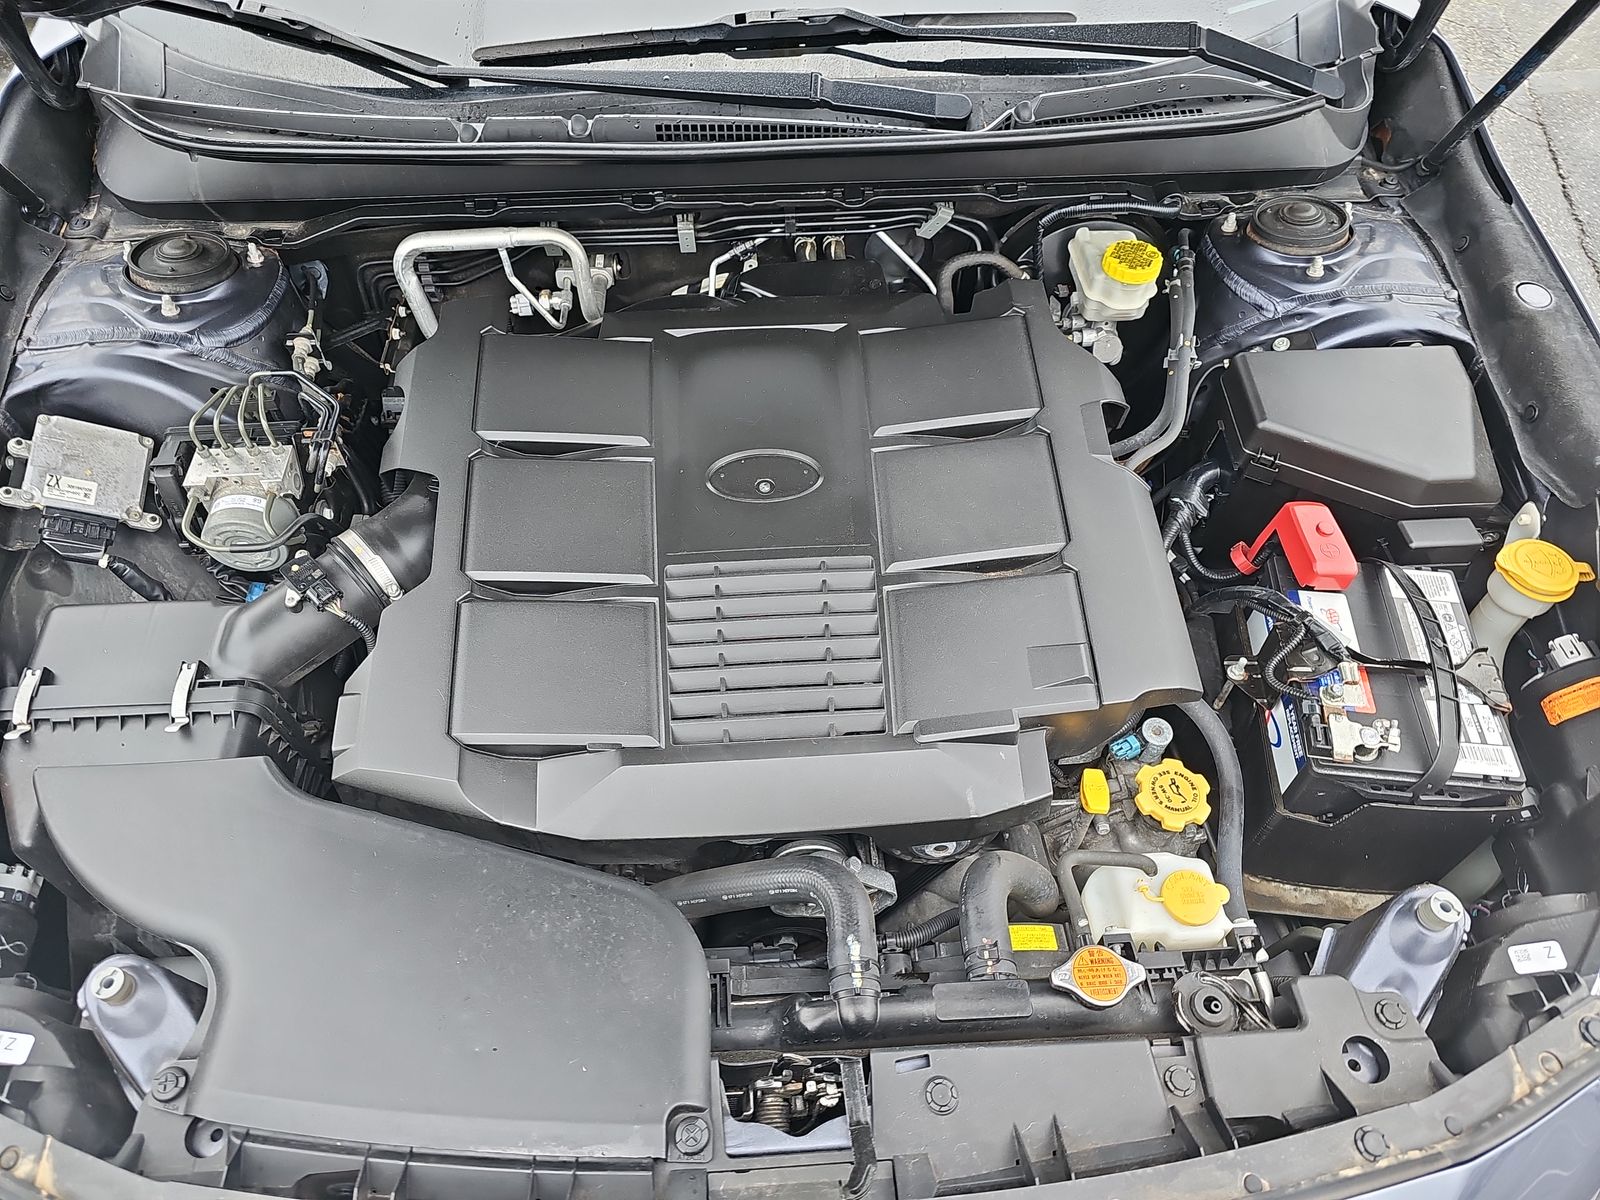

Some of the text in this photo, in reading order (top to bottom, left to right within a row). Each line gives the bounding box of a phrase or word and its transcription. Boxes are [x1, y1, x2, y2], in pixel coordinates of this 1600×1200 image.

[47, 474, 62, 489] ZX
[1290, 710, 1298, 733] YEAR
[1295, 733, 1304, 758] FREE
[1174, 771, 1199, 803] ENGINE OIL
[1543, 945, 1556, 959] Z
[1089, 956, 1115, 965] WARNING
[4, 1037, 17, 1051] Z
